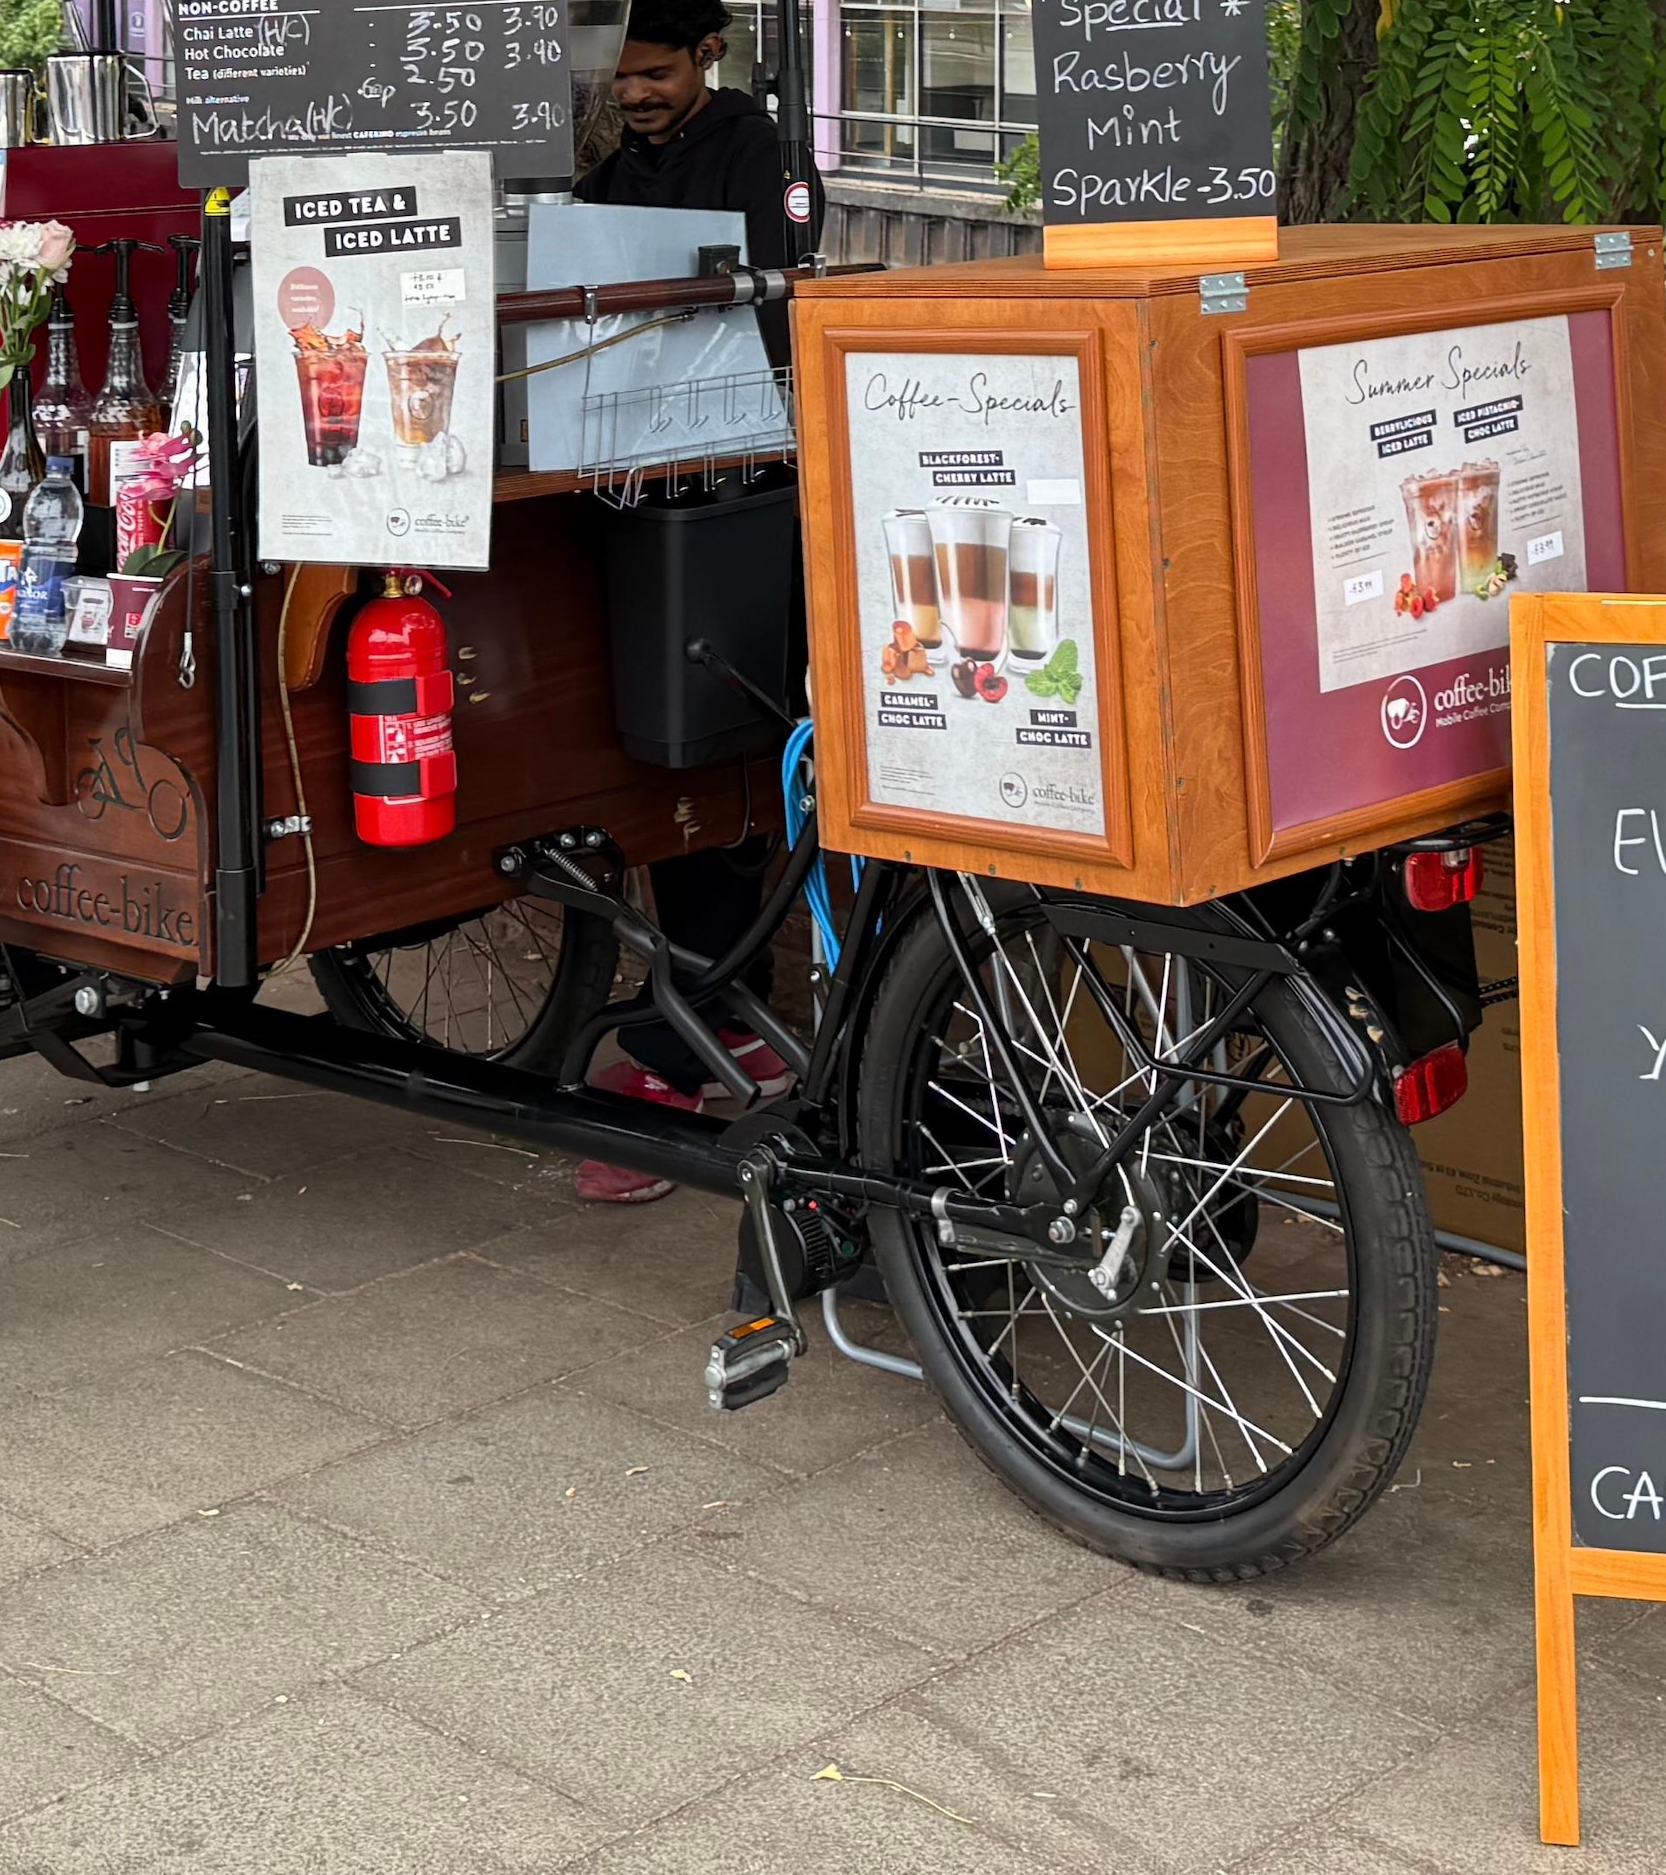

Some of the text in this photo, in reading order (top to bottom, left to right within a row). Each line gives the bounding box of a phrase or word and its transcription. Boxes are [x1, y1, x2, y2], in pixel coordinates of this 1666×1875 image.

[183, 27, 214, 42] Chai
[218, 25, 254, 40] Latte
[184, 47, 210, 61] Hot
[213, 43, 285, 60] Chocolate
[185, 66, 209, 80] Tea
[1053, 50, 1242, 116] Rasberry
[1087, 104, 1183, 151] Mint
[294, 193, 406, 220] ICED TEA &
[335, 224, 452, 251] ICED LATTE
[1344, 341, 1532, 405] Summer Specials
[1457, 410, 1477, 423] ICED
[1381, 418, 1516, 455] ICED LATTE CHOC LATTE
[922, 453, 1000, 465] BLACKFOREST-
[935, 471, 1013, 484] CHERRY LATTE
[1434, 664, 1512, 712] coffee-bi
[884, 694, 934, 707] CARAMEL-
[881, 713, 944, 727] CHOC LATTE
[1037, 713, 1069, 724] MINT-
[1019, 731, 1088, 746] CHOC LATTE
[17, 863, 199, 947] coffee-bike
